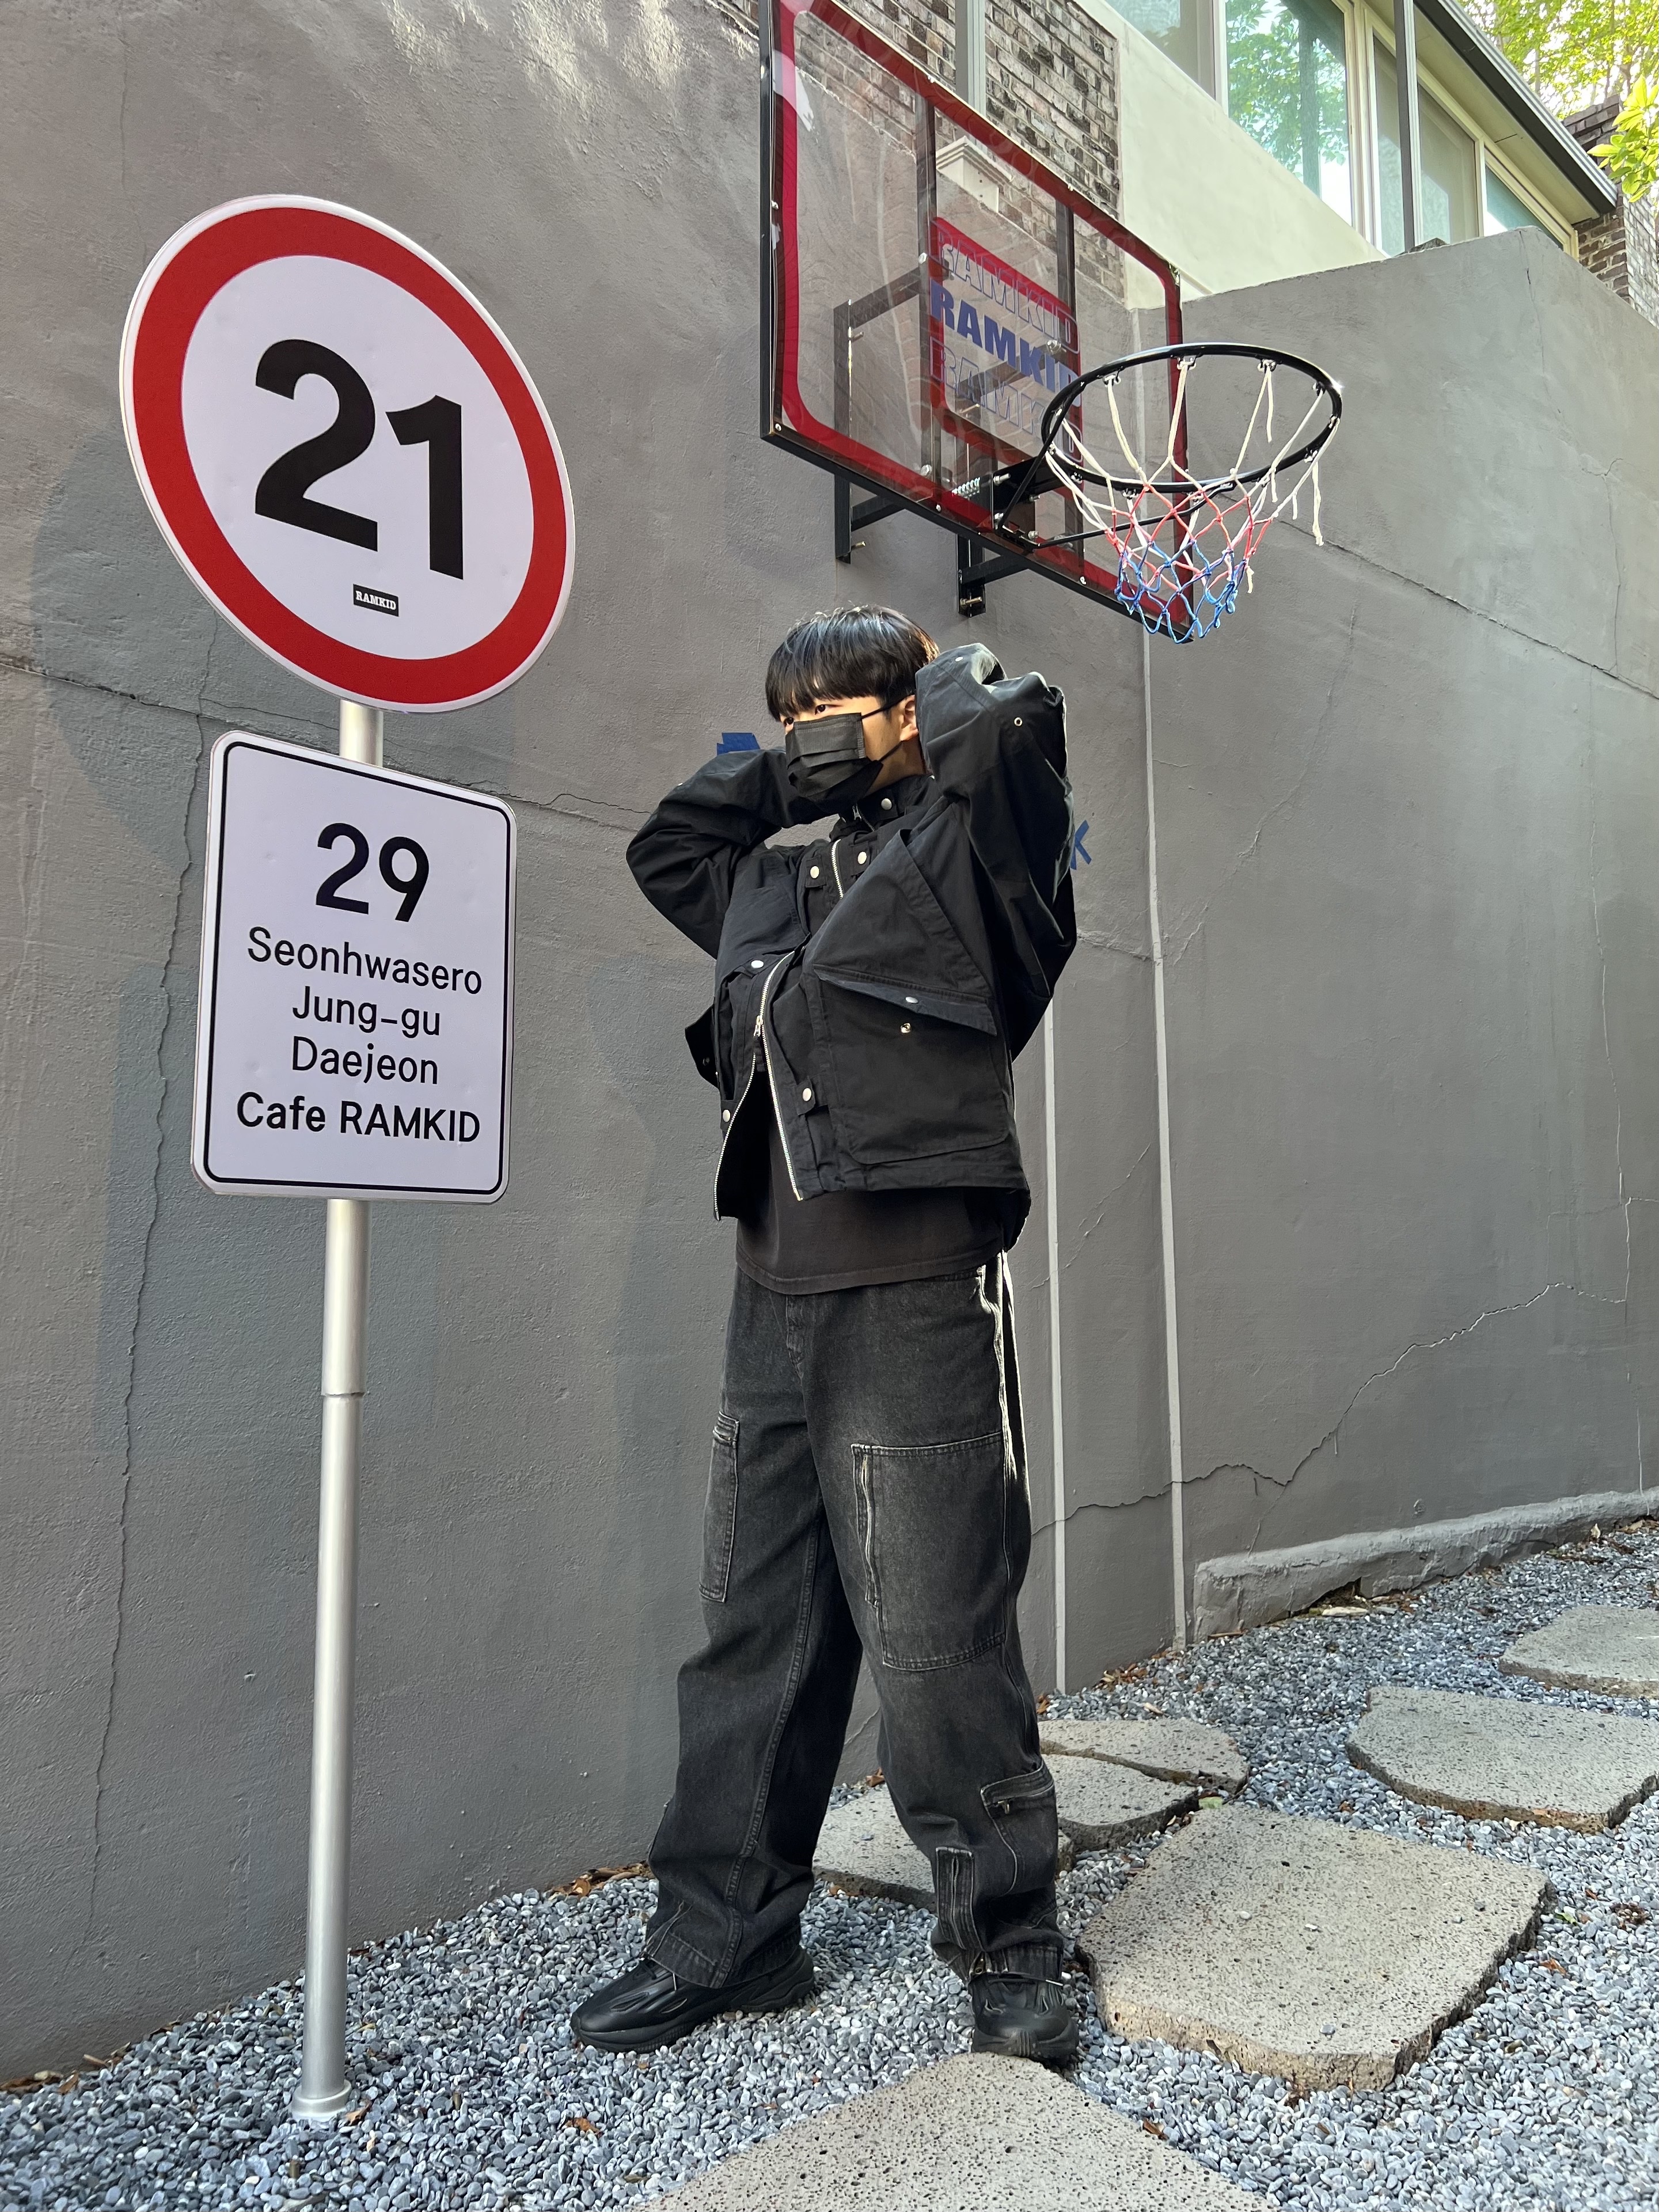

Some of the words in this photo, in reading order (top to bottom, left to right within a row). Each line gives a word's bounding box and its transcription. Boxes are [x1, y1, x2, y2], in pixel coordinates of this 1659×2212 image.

[255, 339, 463, 579] 21
[355, 590, 396, 610] RAMKID
[316, 823, 429, 922] 29
[248, 927, 481, 994] Seonhwasero
[293, 986, 439, 1038] Jung-gu
[293, 1036, 437, 1083] Daejeon
[237, 1092, 325, 1132] Cafe
[341, 1101, 480, 1142] RAMKID
